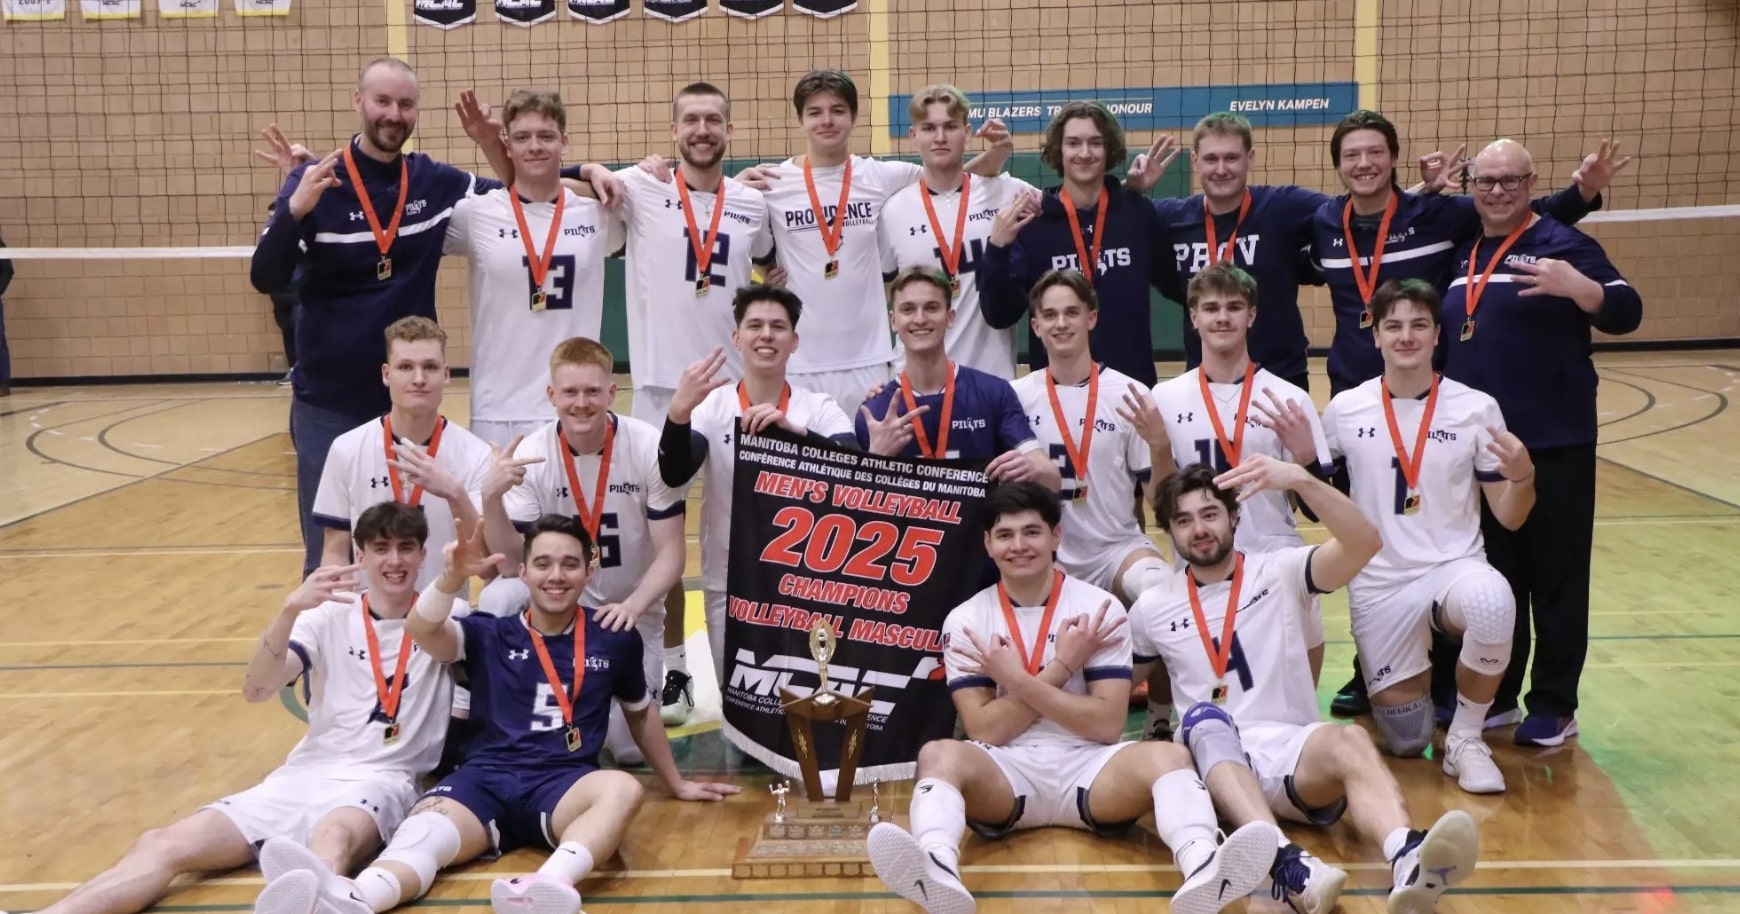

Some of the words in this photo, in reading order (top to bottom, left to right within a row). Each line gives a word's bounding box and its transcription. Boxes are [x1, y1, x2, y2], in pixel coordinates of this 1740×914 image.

[988, 106, 1042, 119] BLAZERS
[1229, 100, 1275, 112] EVELYN
[1277, 98, 1330, 111] KAMPEN
[739, 450, 796, 469] CONFÉRENCE
[798, 461, 852, 479] ATHLÉTIQUE
[854, 471, 873, 482] DES
[922, 481, 936, 491] DU
[937, 483, 986, 498] MANITOBA
[740, 433, 798, 455] MANITOBA
[802, 446, 858, 465] COLLEGES
[861, 457, 914, 473] ATHLETIC
[917, 464, 989, 484] CONFERENCE
[754, 470, 829, 503] MEN'S
[832, 483, 962, 524] VOLLEYBALL
[759, 506, 945, 586] 2025
[778, 573, 911, 614] CHAMPIONS
[728, 595, 844, 638] VOLLEYBALL
[848, 618, 944, 653] MASCUL
[531, 682, 569, 731] 5
